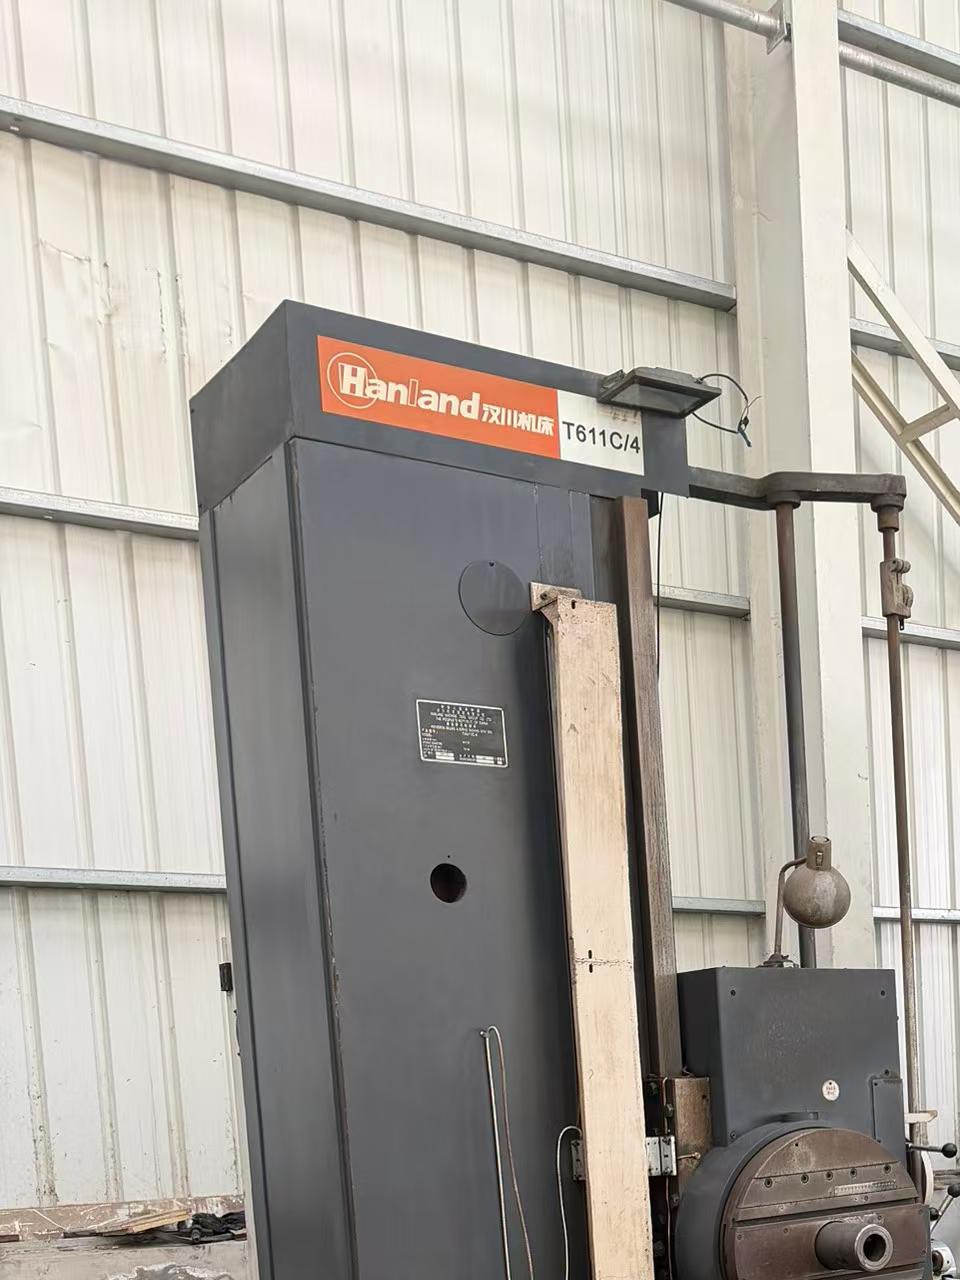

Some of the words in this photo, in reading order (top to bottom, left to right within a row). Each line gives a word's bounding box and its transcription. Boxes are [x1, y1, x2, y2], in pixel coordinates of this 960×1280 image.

[338, 363, 481, 421] Hanland
[481, 403, 555, 437] 汉川机床
[562, 421, 641, 454] T611C/4
